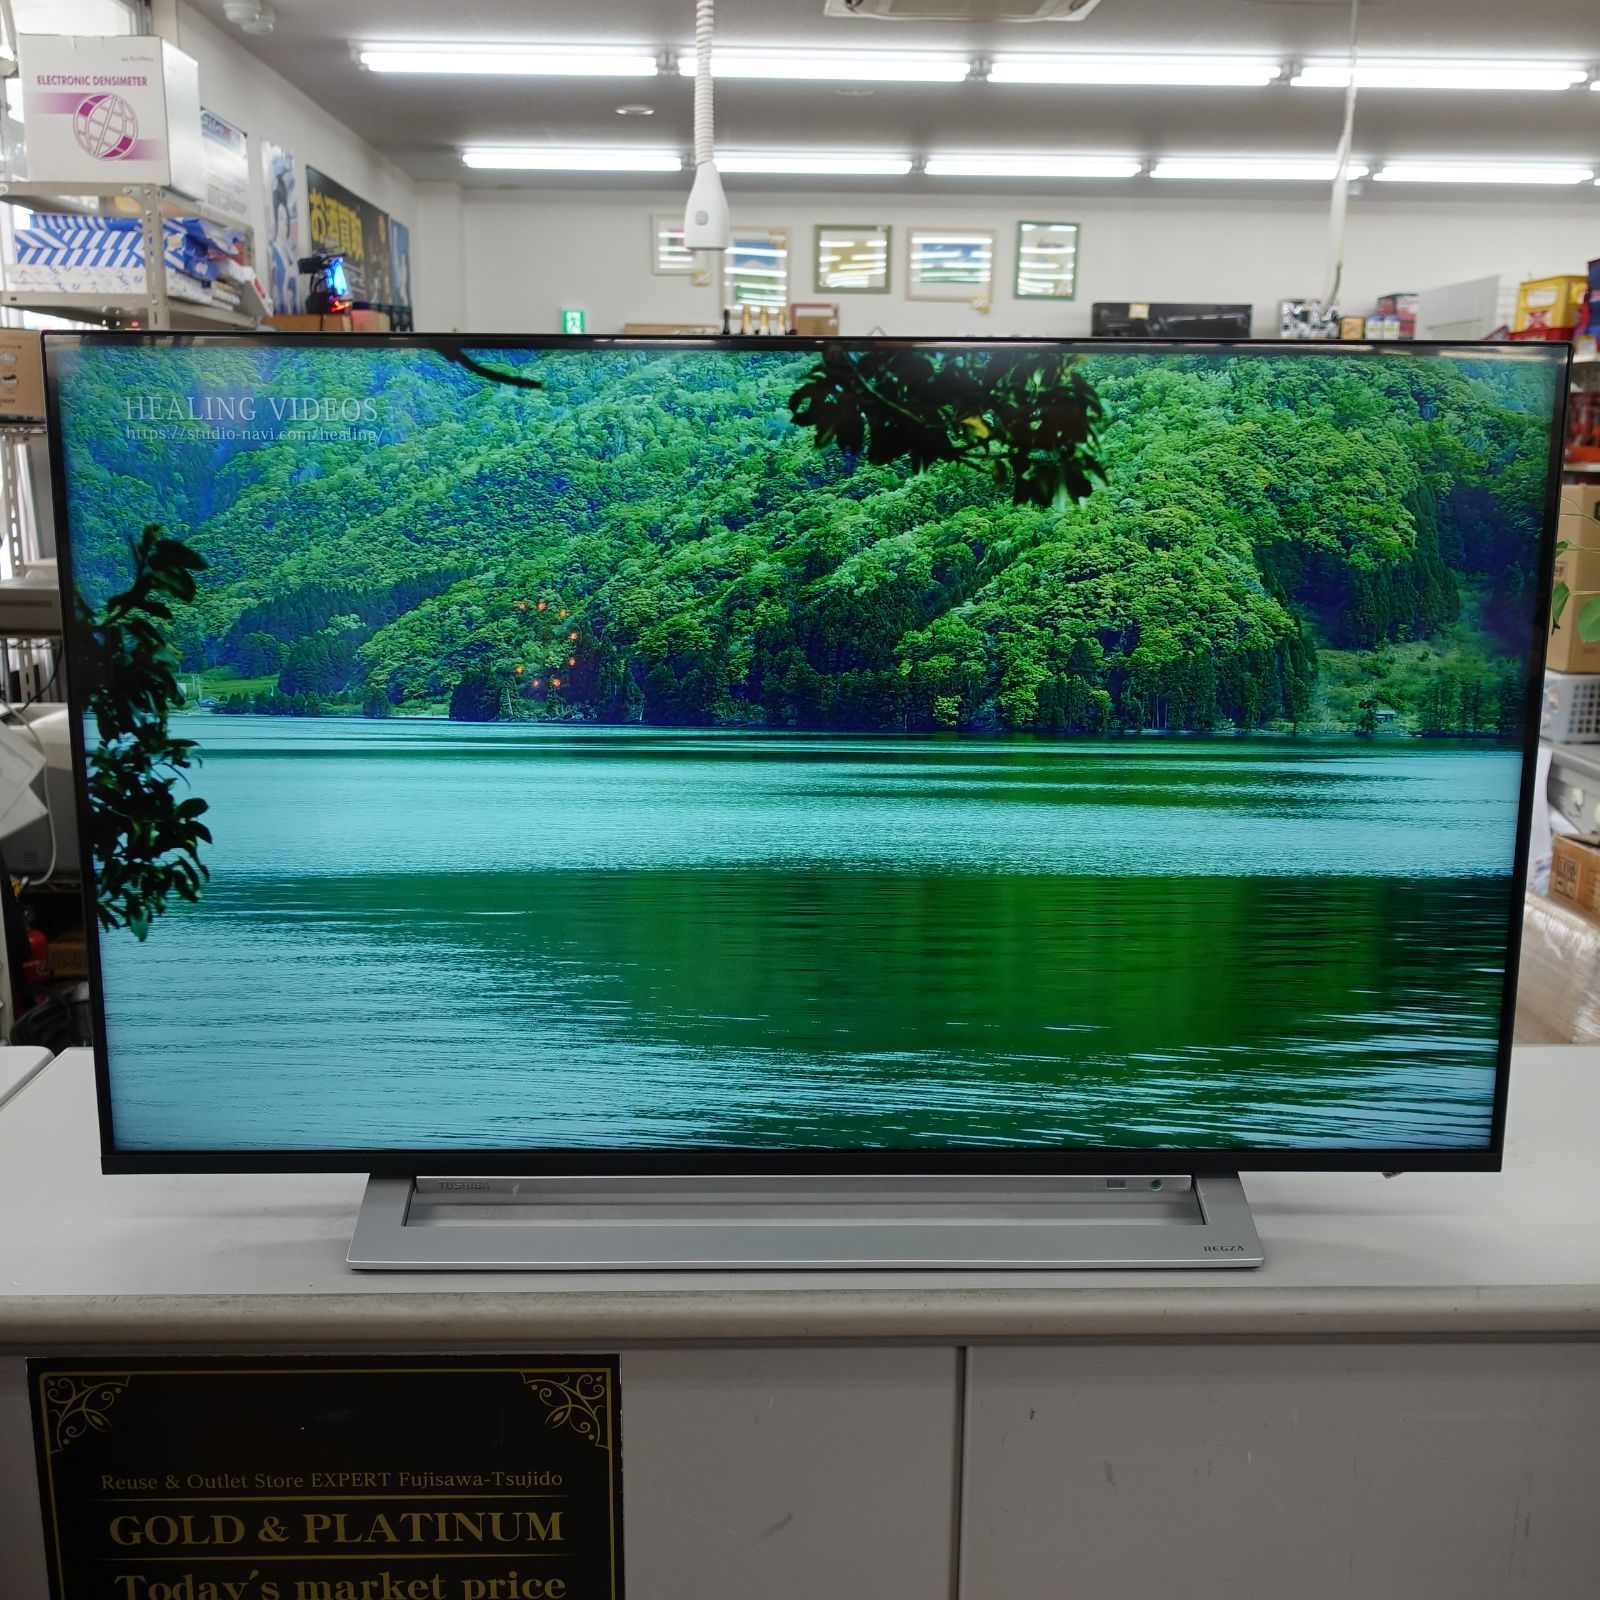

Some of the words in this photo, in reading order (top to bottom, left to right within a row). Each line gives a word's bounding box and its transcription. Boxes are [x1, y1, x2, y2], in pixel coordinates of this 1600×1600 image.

[37, 75, 91, 86] ELECTRONIC
[93, 76, 148, 87] DENSIMETER
[124, 396, 257, 421] HEALING
[269, 397, 378, 421] VIDEOS
[126, 425, 384, 444] https://studio-navi.com/healing/
[439, 1180, 490, 1190] TOSHIBA
[101, 1475, 158, 1490] Reuse
[165, 1474, 181, 1489] &
[187, 1473, 249, 1489] Outlet
[254, 1474, 304, 1489] Store
[311, 1472, 391, 1488] EXPERT
[398, 1470, 564, 1487] Fujisawa-Tsujido
[109, 1514, 246, 1546] GOLD
[257, 1515, 290, 1543] &
[301, 1511, 565, 1544] PLATINUM
[293, 1570, 448, 1600] market
[460, 1570, 567, 1600] price
